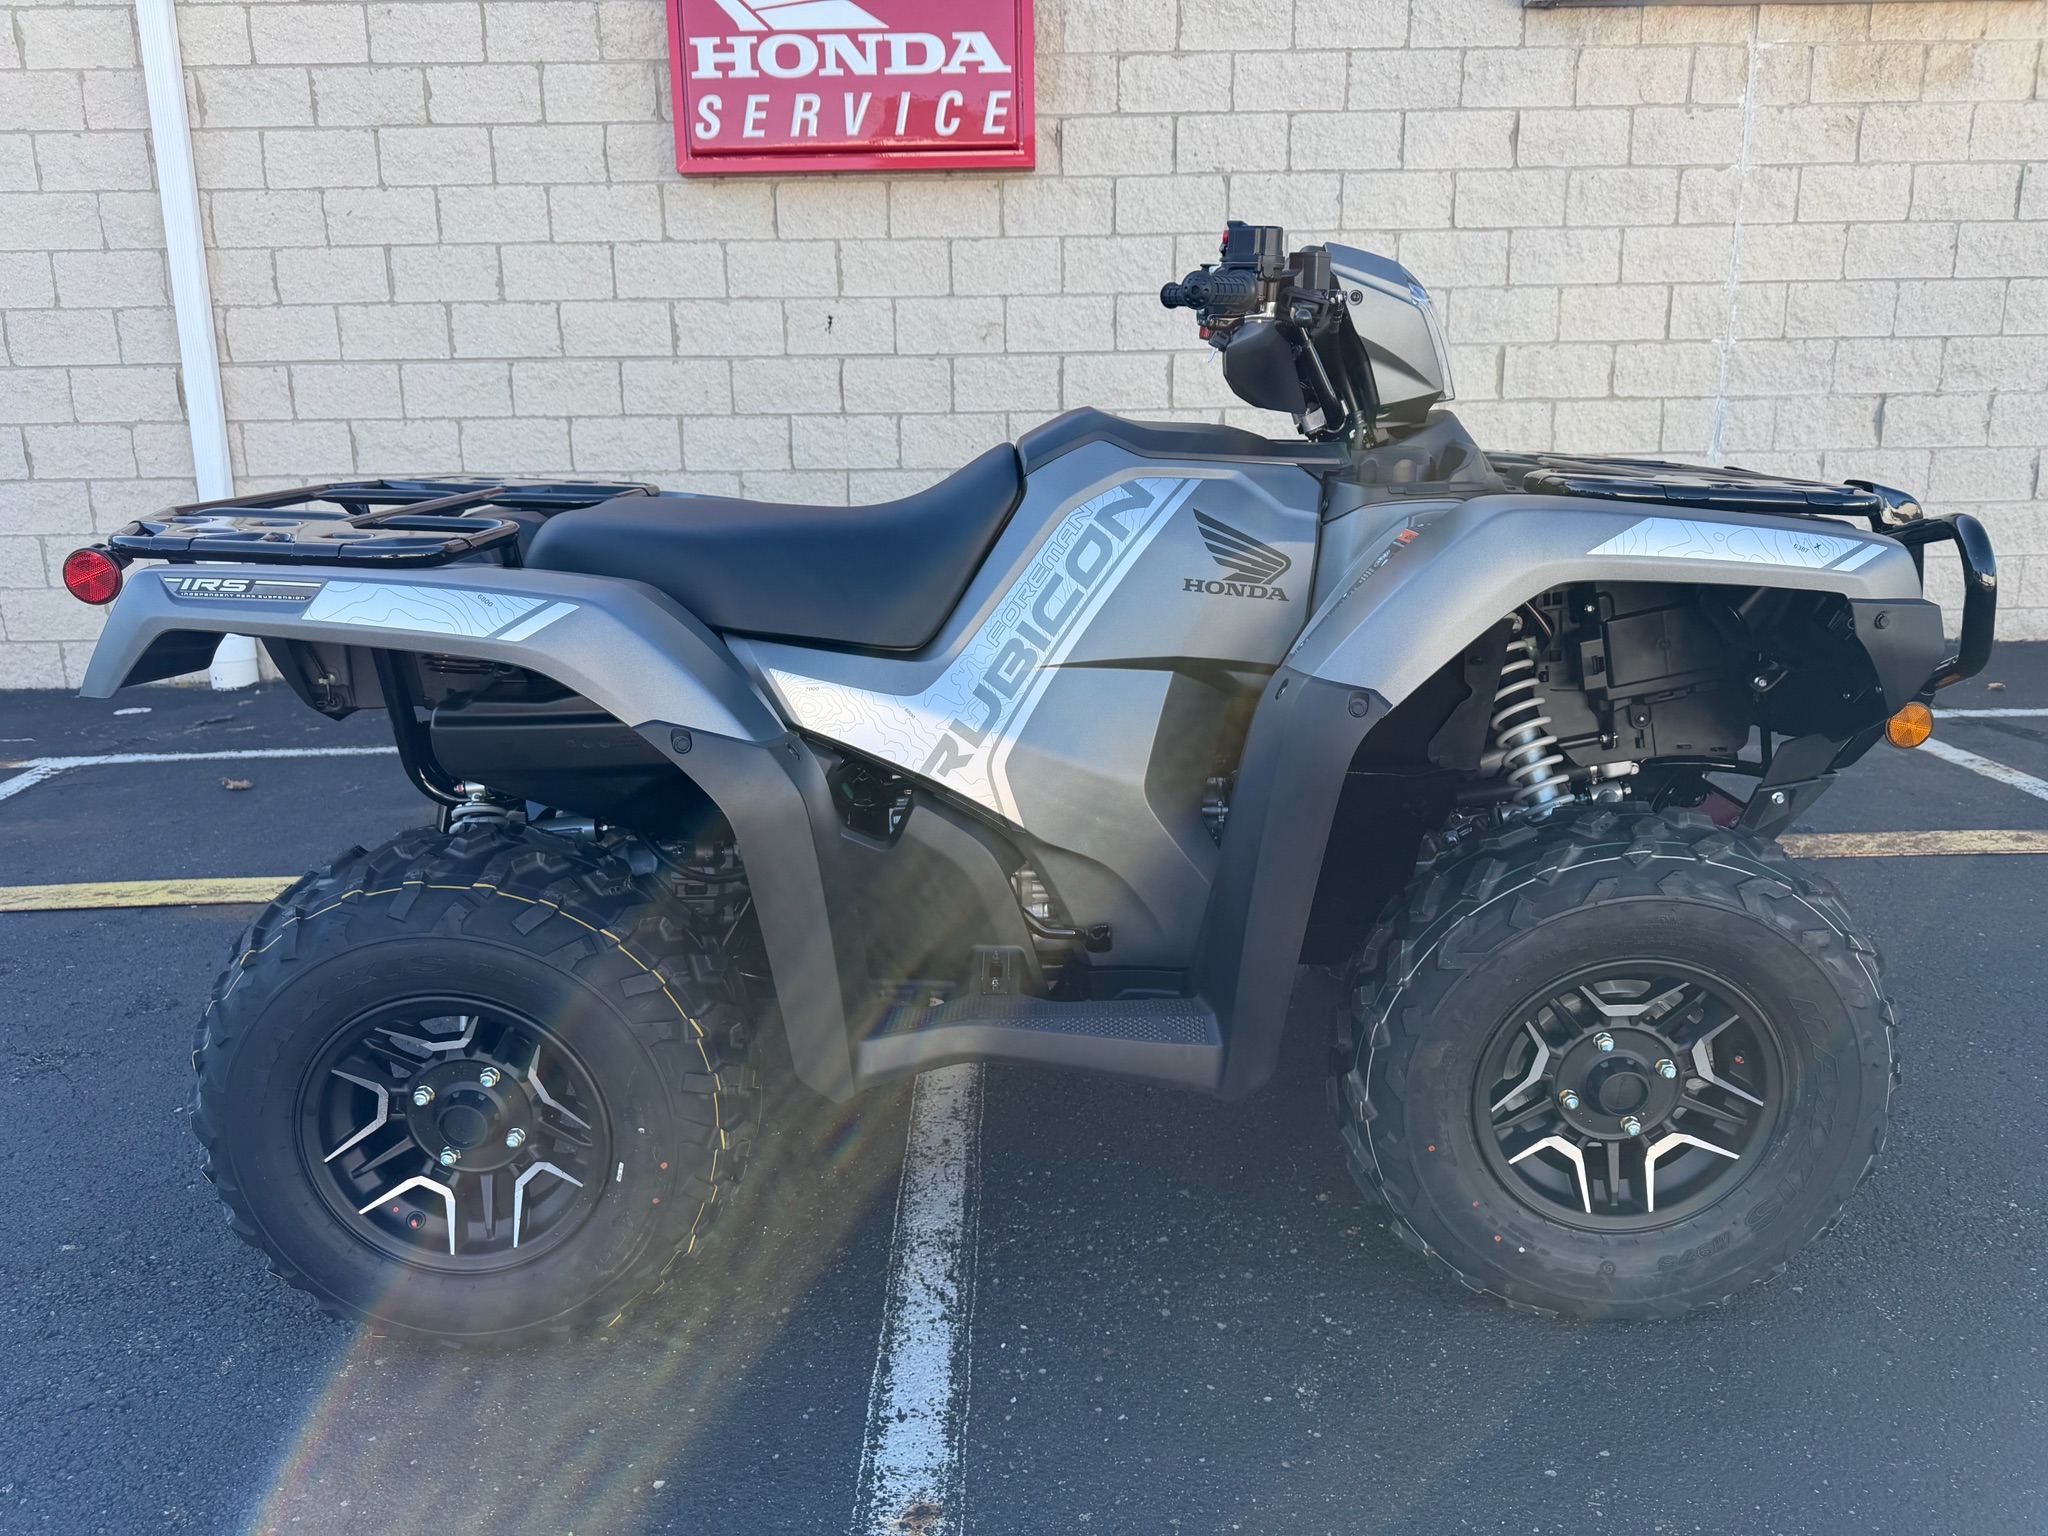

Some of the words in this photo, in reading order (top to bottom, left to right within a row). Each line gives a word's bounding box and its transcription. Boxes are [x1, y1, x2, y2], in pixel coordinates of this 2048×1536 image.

[689, 31, 1012, 80] HONDA
[694, 89, 1012, 140] SERVICE
[180, 578, 250, 592] IRS
[986, 502, 1094, 648] FOREMAN
[1182, 577, 1290, 602] HONDA
[477, 593, 494, 607] 6800
[919, 479, 1156, 779] RUBICON
